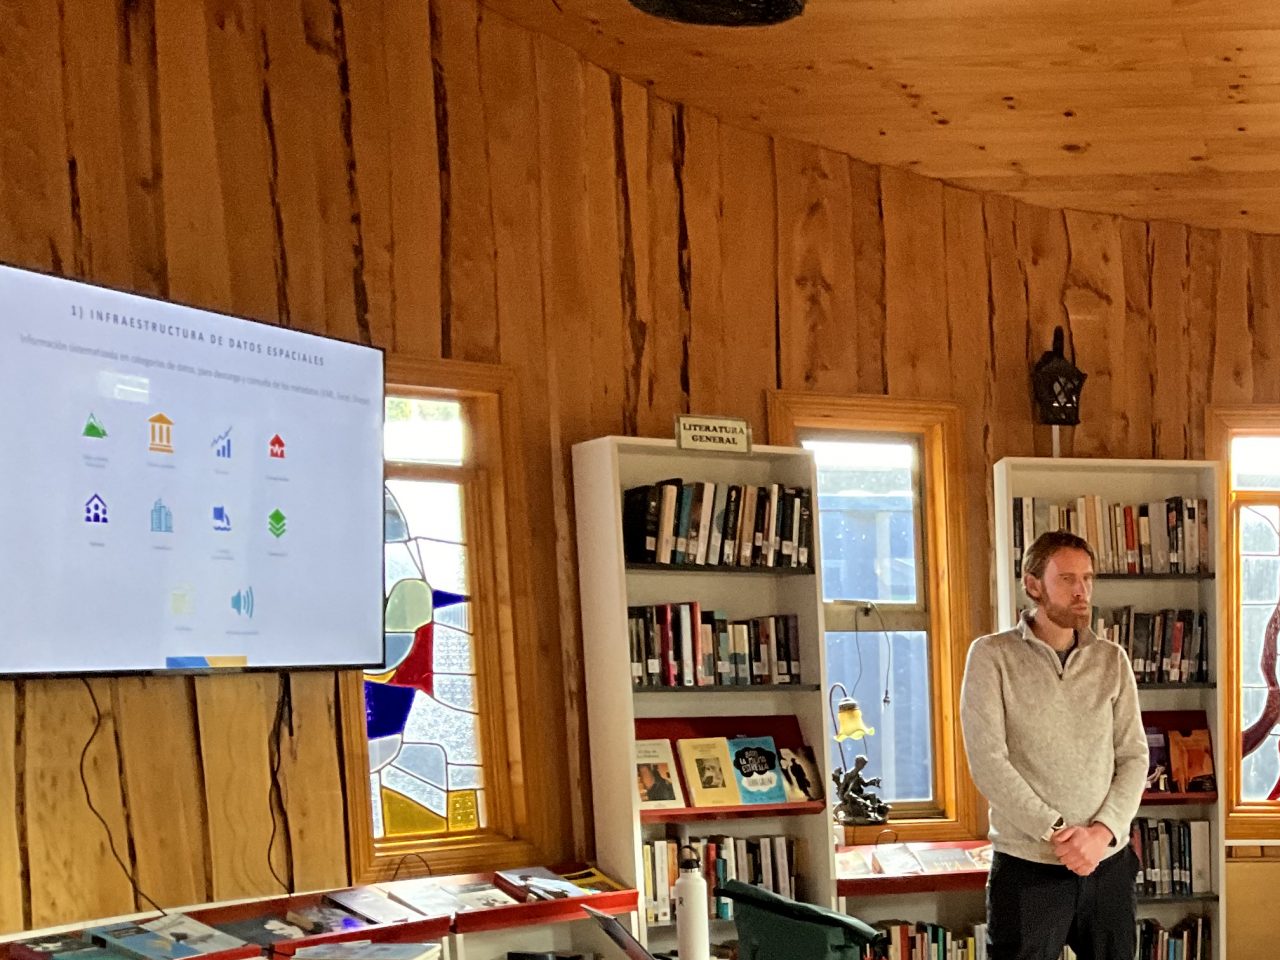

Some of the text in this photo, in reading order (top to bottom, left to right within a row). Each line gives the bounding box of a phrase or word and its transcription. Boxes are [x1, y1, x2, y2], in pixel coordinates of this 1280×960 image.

[71, 305, 325, 366] 1) INFRAESTRUCTURA DE DATOS ESPACIALES
[682, 423, 745, 435] LITERATURA
[691, 434, 738, 445] GENERAL
